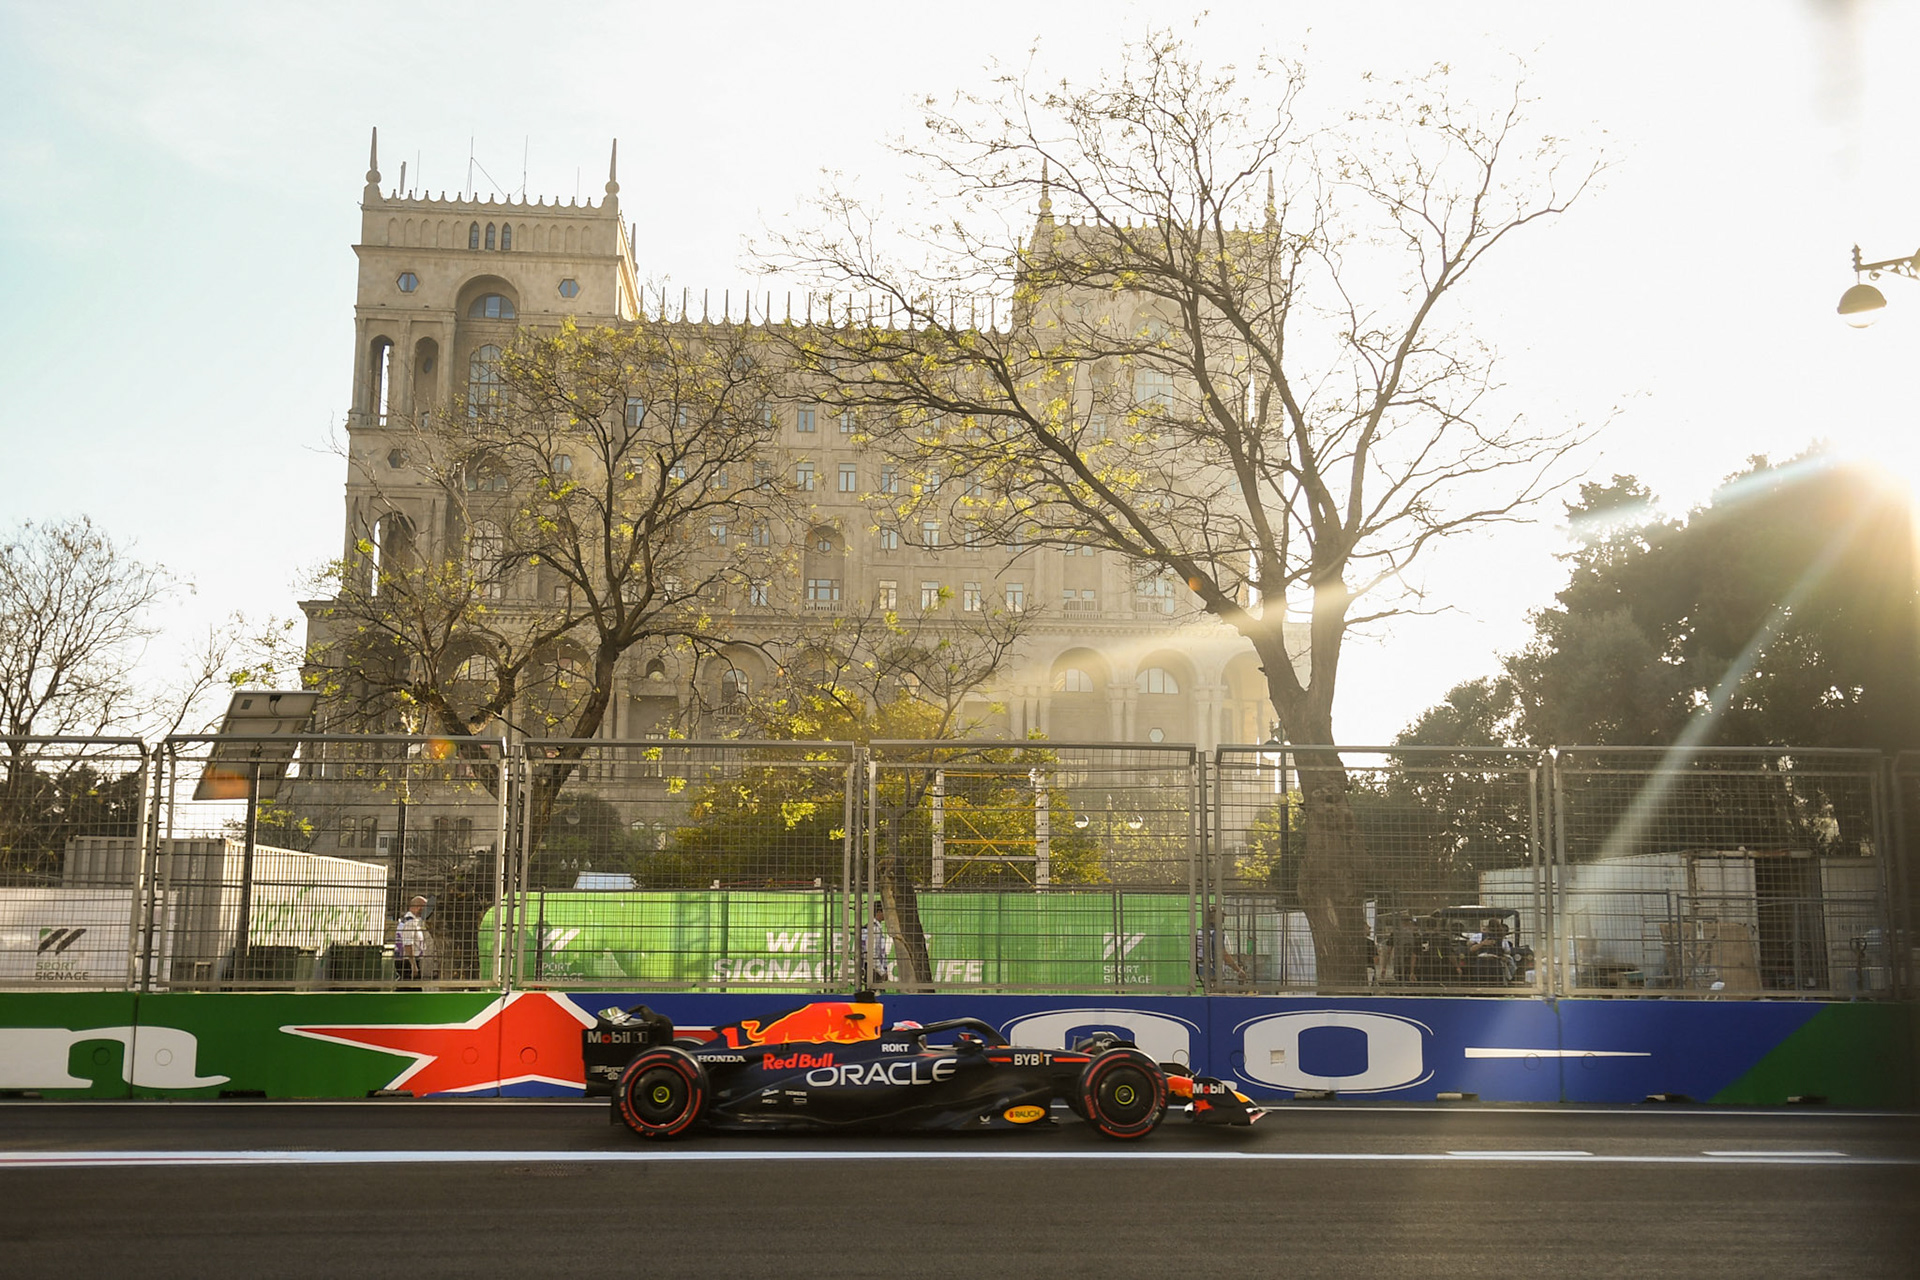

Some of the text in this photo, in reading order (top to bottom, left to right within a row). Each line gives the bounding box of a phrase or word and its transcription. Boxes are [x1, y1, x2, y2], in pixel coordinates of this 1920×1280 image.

[766, 931, 821, 953] WE
[36, 960, 76, 971] SPORT
[542, 962, 572, 972] PORT
[933, 959, 985, 982] IFE
[35, 971, 88, 981] SIGNAGE
[541, 972, 585, 982] IGNAGE
[587, 1031, 631, 1043] Mobil
[881, 1043, 910, 1052] ROKT
[697, 1054, 747, 1063] HONDA
[762, 1051, 835, 1070] Red Bull
[1013, 1051, 1053, 1066] BYBIT
[806, 1059, 958, 1087] ORACLE
[1192, 1082, 1226, 1095] Mobil
[1014, 1109, 1041, 1119] RAUCH
